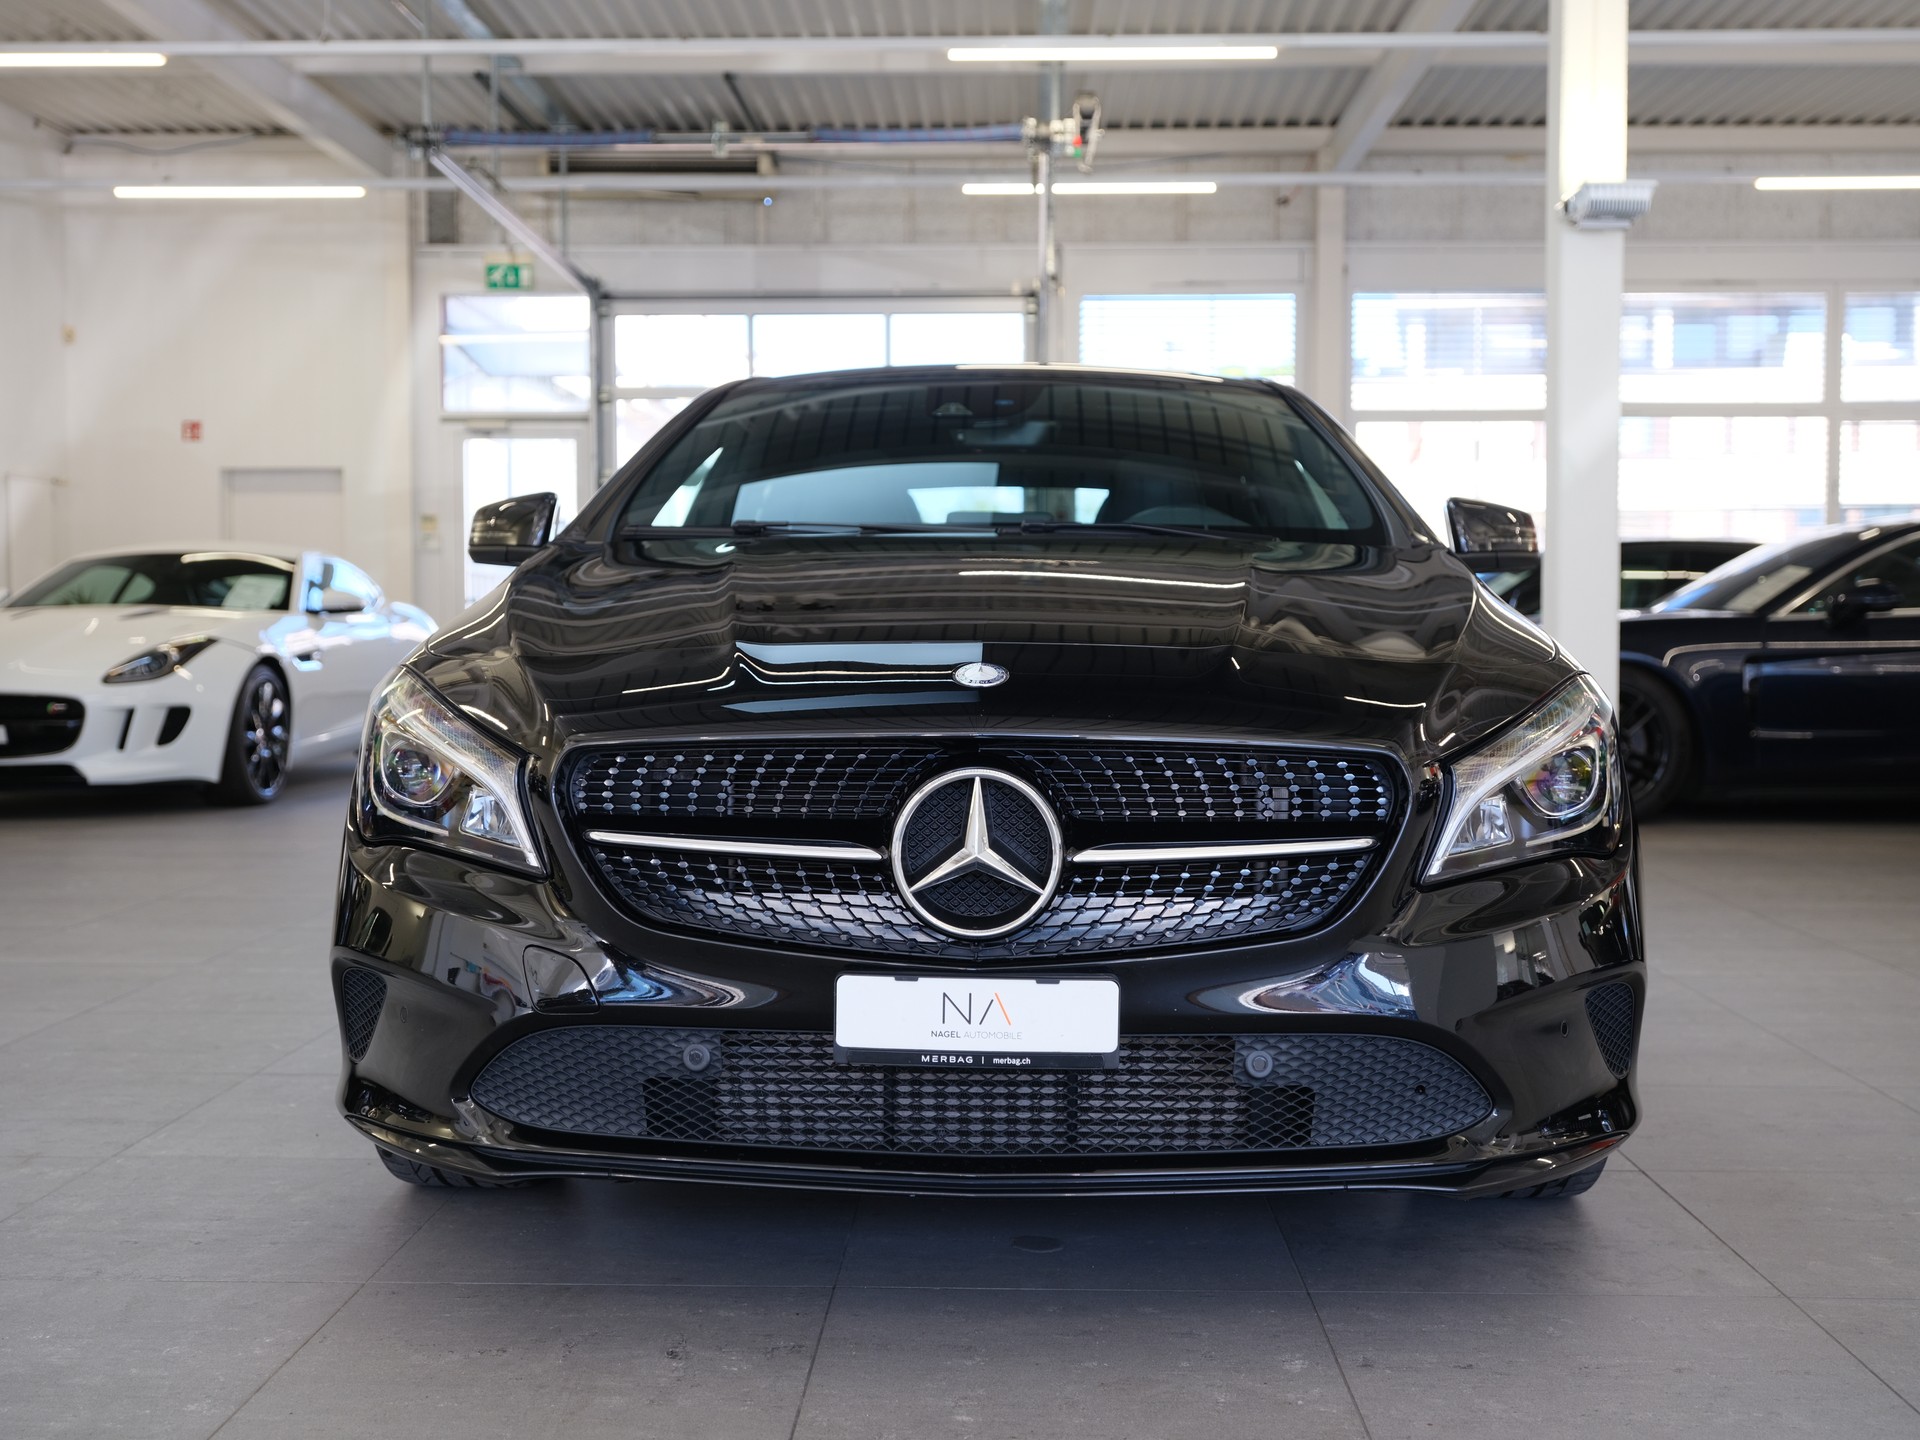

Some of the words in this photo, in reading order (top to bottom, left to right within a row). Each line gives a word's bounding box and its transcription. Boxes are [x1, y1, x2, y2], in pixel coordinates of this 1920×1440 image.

[930, 1030, 961, 1039] NAGEL
[963, 1031, 1022, 1040] AUTOMOBILE
[921, 1055, 973, 1064] MERBAG
[992, 1056, 1031, 1066] merbag.ch
